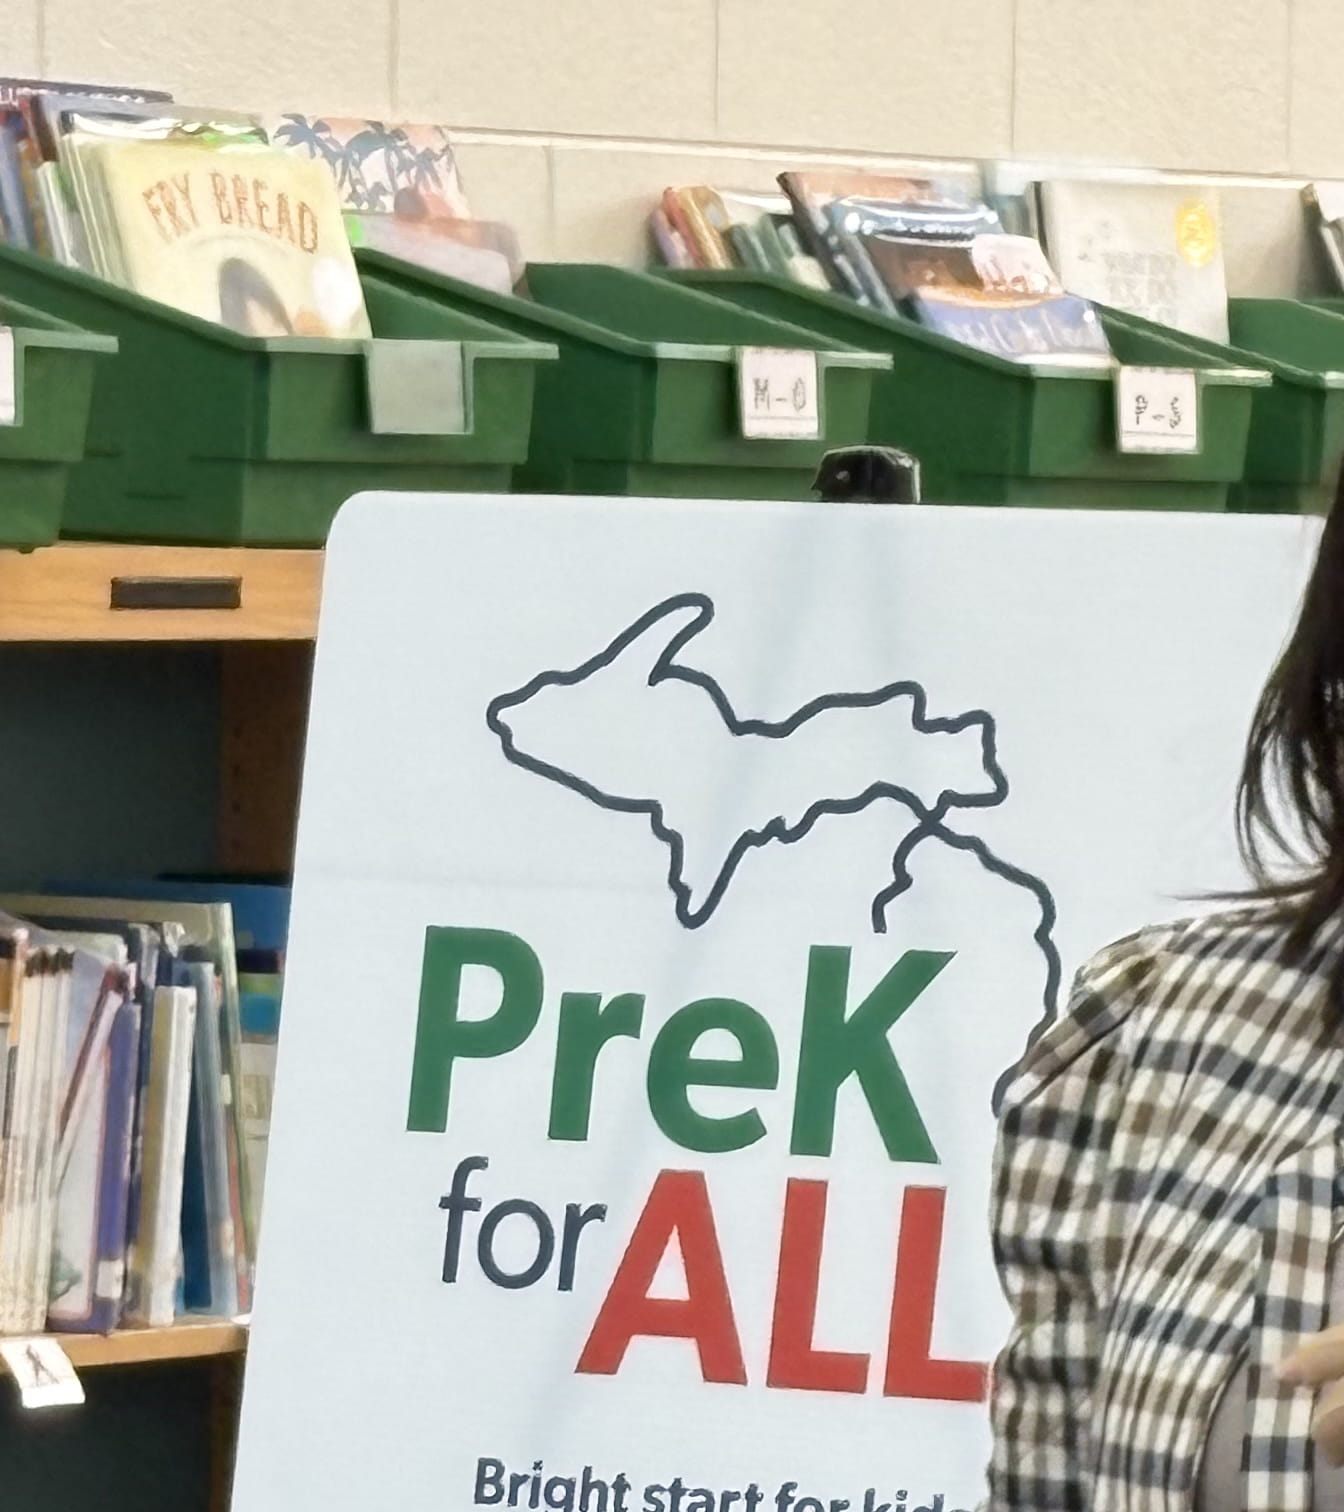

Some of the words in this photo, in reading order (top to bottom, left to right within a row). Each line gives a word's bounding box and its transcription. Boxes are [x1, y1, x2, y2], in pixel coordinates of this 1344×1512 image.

[142, 173, 199, 245] FRY
[210, 170, 319, 254] BREAD
[407, 926, 958, 1165] PreK
[438, 1155, 607, 1293] for
[575, 1168, 991, 1403] ALL
